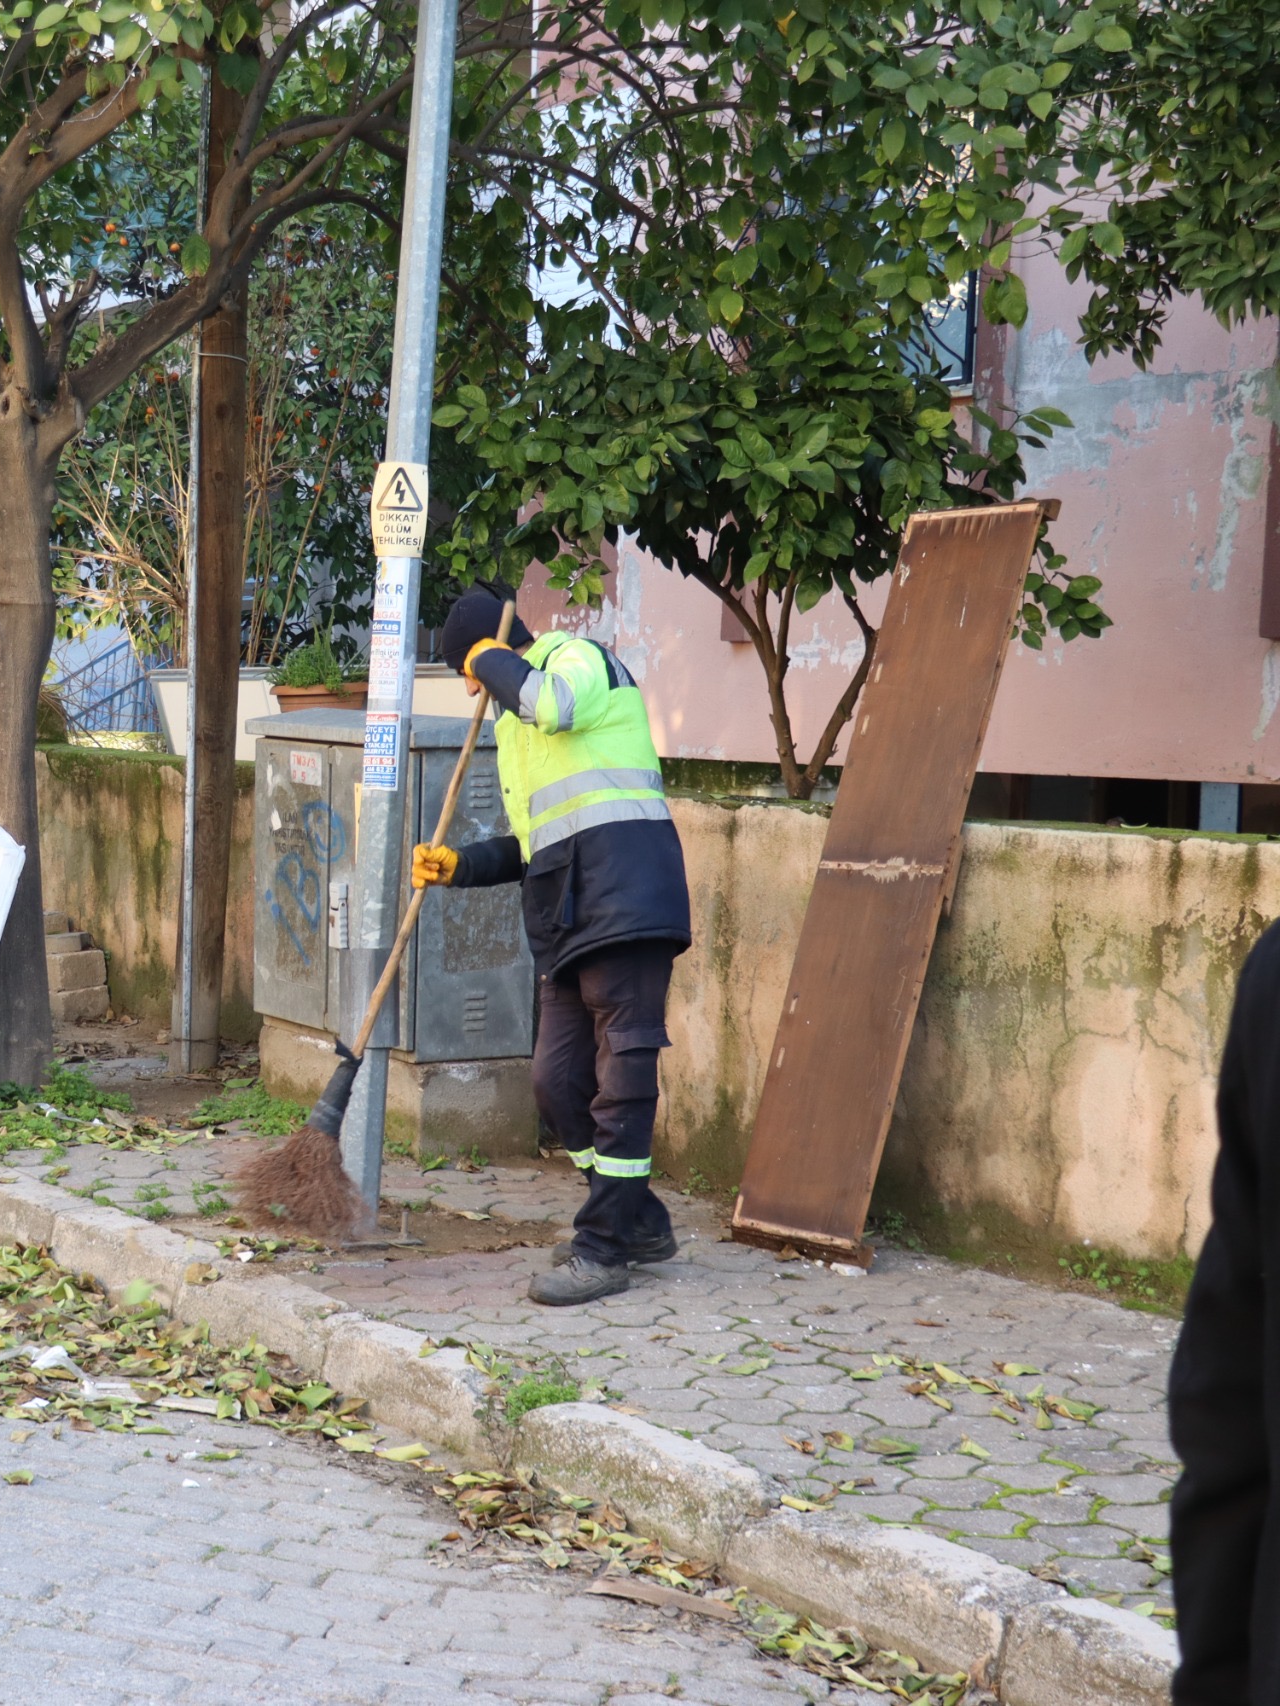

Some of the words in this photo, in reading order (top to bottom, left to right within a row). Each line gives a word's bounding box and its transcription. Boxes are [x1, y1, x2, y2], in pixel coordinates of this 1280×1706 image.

[379, 512, 419, 523] DİKKAT!
[383, 523, 412, 534] ÖLÜM
[375, 535, 422, 546] TEHLİKESİ
